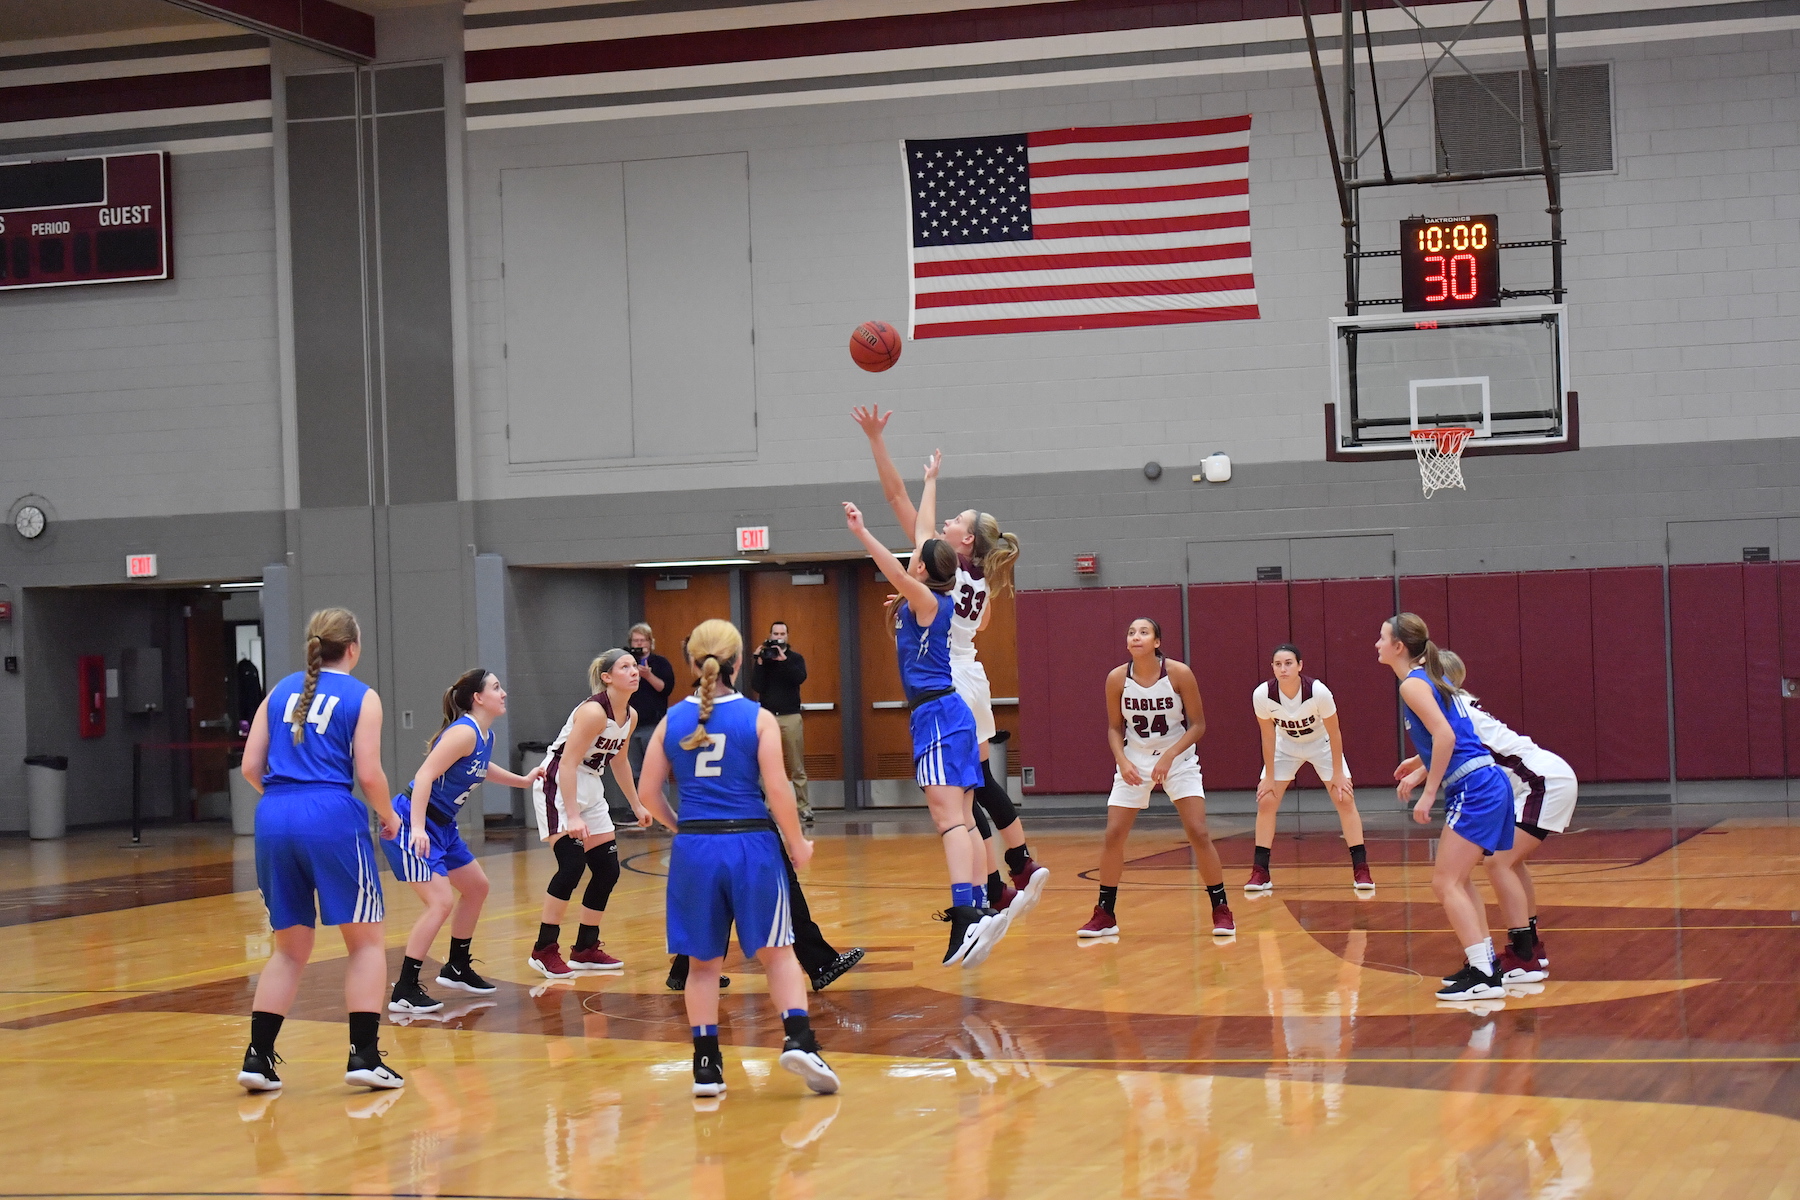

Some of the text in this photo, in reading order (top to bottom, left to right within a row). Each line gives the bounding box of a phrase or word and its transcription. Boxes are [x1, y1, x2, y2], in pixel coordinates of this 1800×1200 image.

[99, 205, 151, 226] GUEST
[31, 221, 70, 236] PERIOD
[1419, 223, 1487, 252] 10:00
[1424, 254, 1477, 302] 30
[741, 529, 764, 549] EXIT
[131, 557, 151, 575] EXIT
[954, 584, 987, 621] 33
[1124, 696, 1174, 711] EAGLES
[1131, 714, 1169, 738] 24
[1273, 714, 1316, 729] EAGLES
[694, 733, 727, 777] 2
